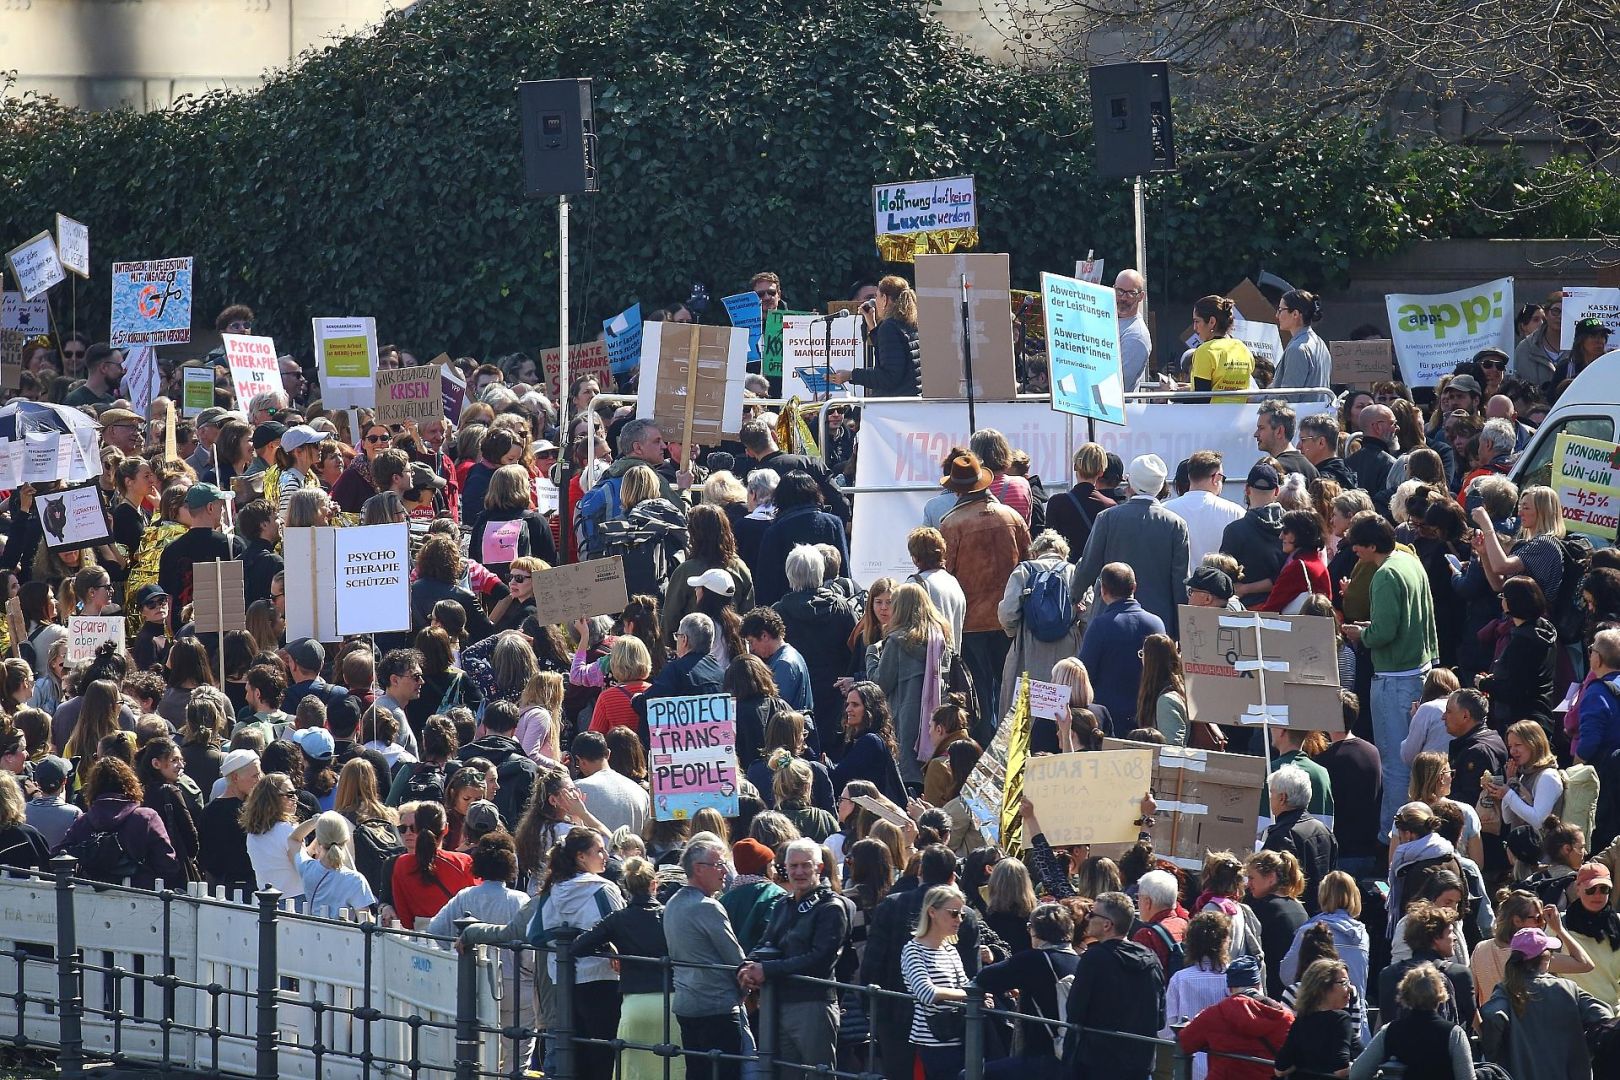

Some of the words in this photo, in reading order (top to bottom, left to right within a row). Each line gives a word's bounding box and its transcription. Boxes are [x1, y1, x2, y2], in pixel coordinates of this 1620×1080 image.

[877, 188, 931, 212] Hoffnung
[932, 185, 949, 204] darf
[949, 188, 972, 204] kein
[887, 213, 937, 231] Luxus
[938, 206, 970, 223] werden
[1050, 284, 1096, 305] Abwertung
[1051, 296, 1065, 307] der
[1066, 299, 1111, 318] Leistungen
[1397, 290, 1503, 340] app:
[1588, 304, 1619, 312] KASSEN
[789, 338, 862, 346] PSYCHOTERAPIE-
[1054, 327, 1100, 347] Abwertung
[1101, 338, 1114, 349] der
[230, 340, 271, 354] PSYCHO
[608, 349, 623, 357] uns
[831, 349, 857, 357] HEUTE
[228, 354, 278, 371] THERAPIE
[251, 371, 265, 381] IST
[376, 370, 394, 389] WIR
[396, 367, 437, 382] BEHANDELN
[390, 382, 430, 400] KRISEN
[377, 405, 391, 420] IHR
[1561, 460, 1613, 486] WIN-WIN
[1561, 505, 1619, 529] OOSE-LOOSE
[347, 550, 396, 563] PSYCHO
[344, 563, 400, 575] THERAPIE
[346, 576, 399, 588] SCHÜTZEN
[73, 620, 107, 635] Sparen
[75, 635, 98, 646] aber
[649, 695, 732, 730] PROTECT
[651, 726, 720, 754] TRANS
[655, 761, 729, 791] PEOPLE
